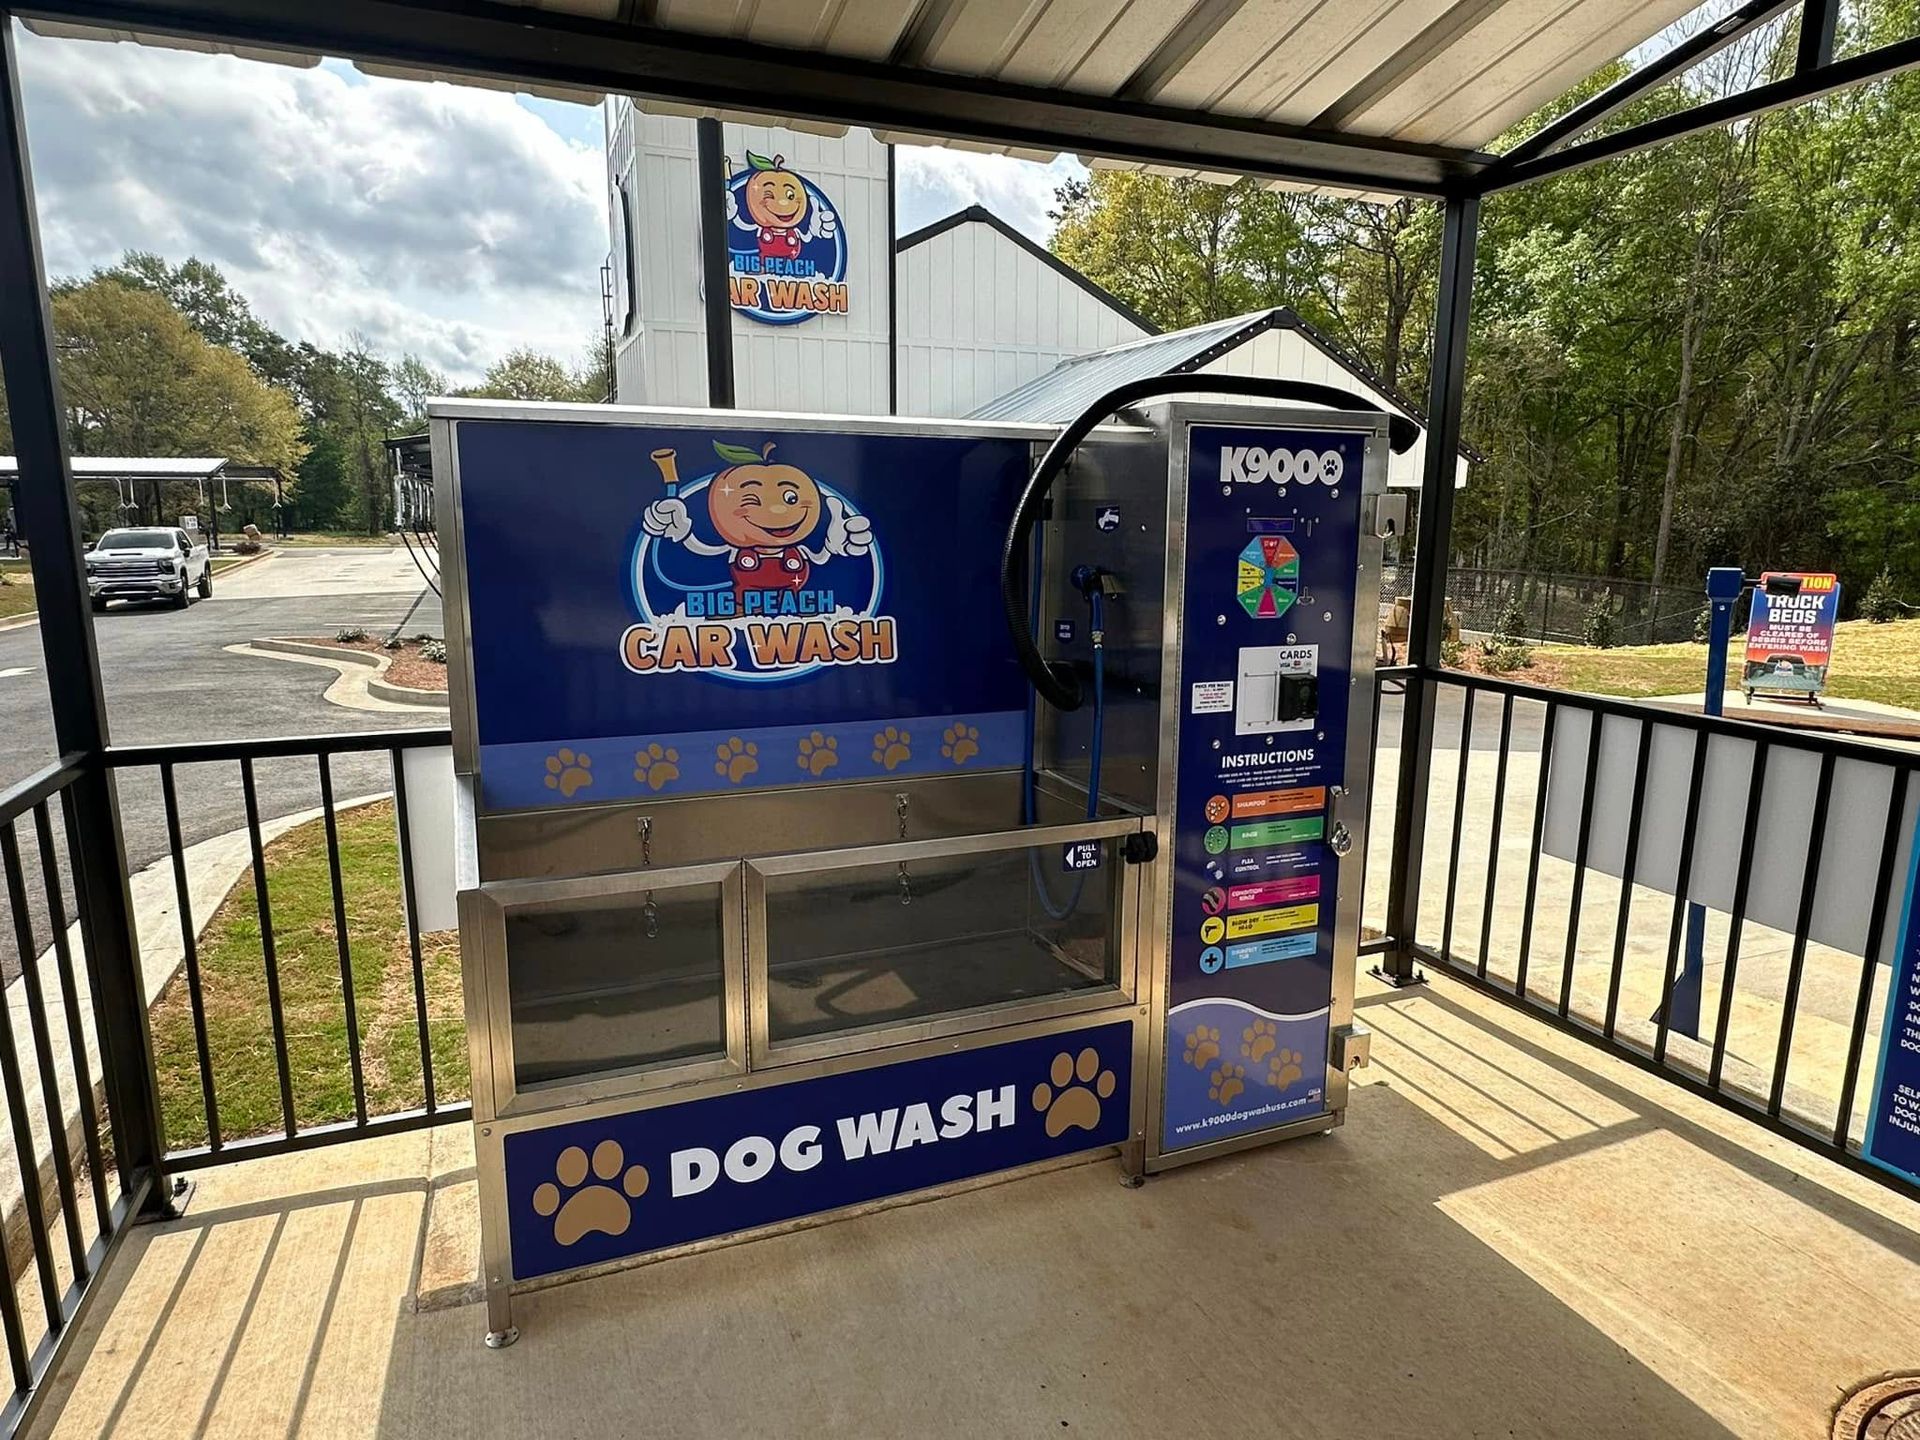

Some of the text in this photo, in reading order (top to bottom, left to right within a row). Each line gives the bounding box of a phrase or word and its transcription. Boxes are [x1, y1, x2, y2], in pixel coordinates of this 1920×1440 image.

[734, 255, 816, 276] BIG PEACH
[729, 276, 848, 313] AR WASH
[1220, 446, 1344, 486] K9000
[1802, 576, 1832, 589] TION
[686, 590, 835, 616] BIG PEACH
[1765, 594, 1826, 610] TRUCK
[1768, 609, 1817, 624] BEDS
[1760, 630, 1804, 638] CLEARED
[624, 617, 895, 670] CAR WASH
[1280, 650, 1312, 660] CARDS
[1222, 749, 1315, 768] INSTRUCTIONS
[1077, 844, 1096, 853] PULL
[1082, 852, 1092, 860] TO
[1076, 859, 1097, 868] OPEN
[1893, 1093, 1907, 1105] TO
[1175, 1097, 1307, 1134] www.k9000dogwashusa.com
[1894, 1105, 1917, 1122] DOG
[671, 1084, 1015, 1198] DOG WASH
